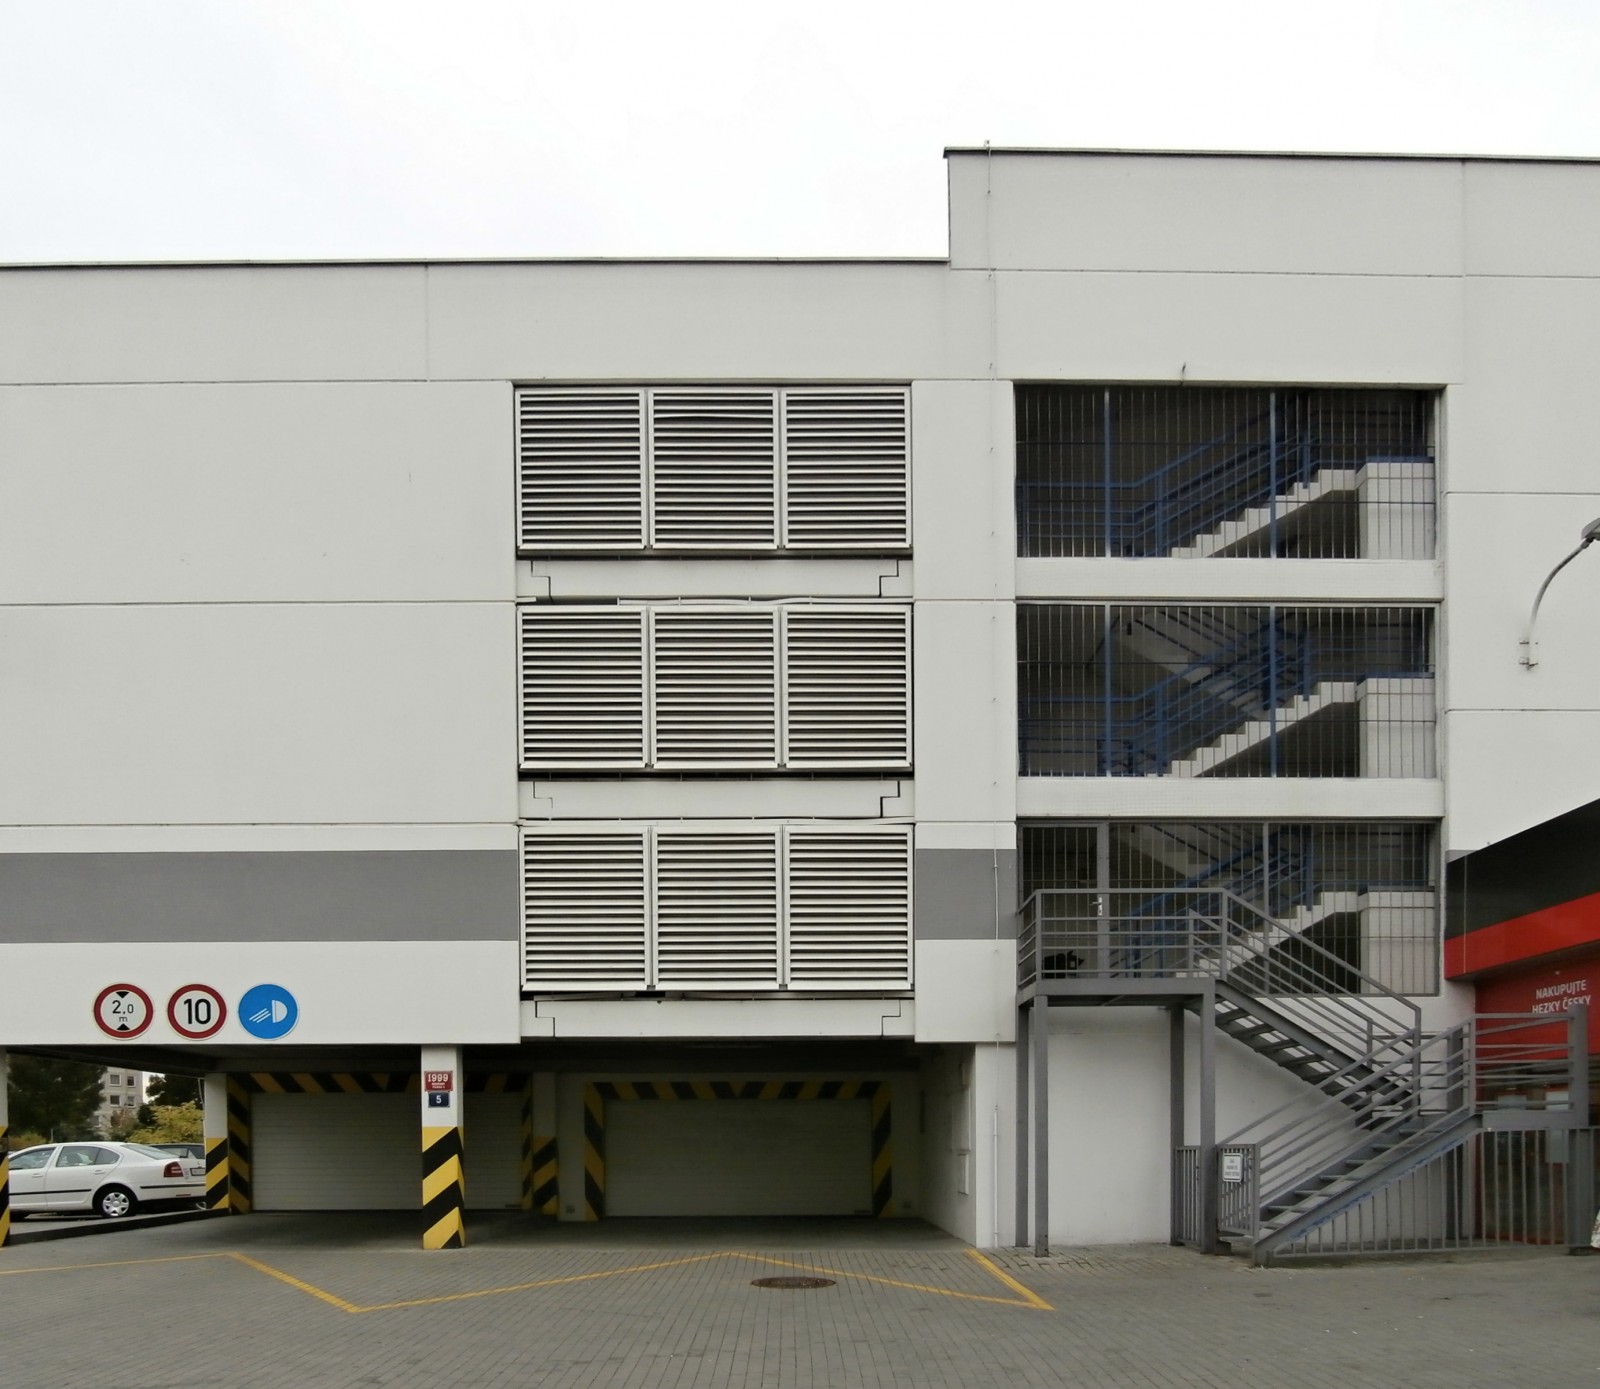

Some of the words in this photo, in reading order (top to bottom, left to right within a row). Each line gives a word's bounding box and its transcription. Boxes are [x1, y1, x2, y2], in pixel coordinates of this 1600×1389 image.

[1535, 979, 1587, 1000] NAKUPUJTE
[112, 1000, 134, 1015] 2,0
[183, 998, 211, 1025] 10
[1532, 1000, 1561, 1014] HEZKY
[427, 1073, 449, 1083] 1999
[436, 1095, 442, 1104] 5
